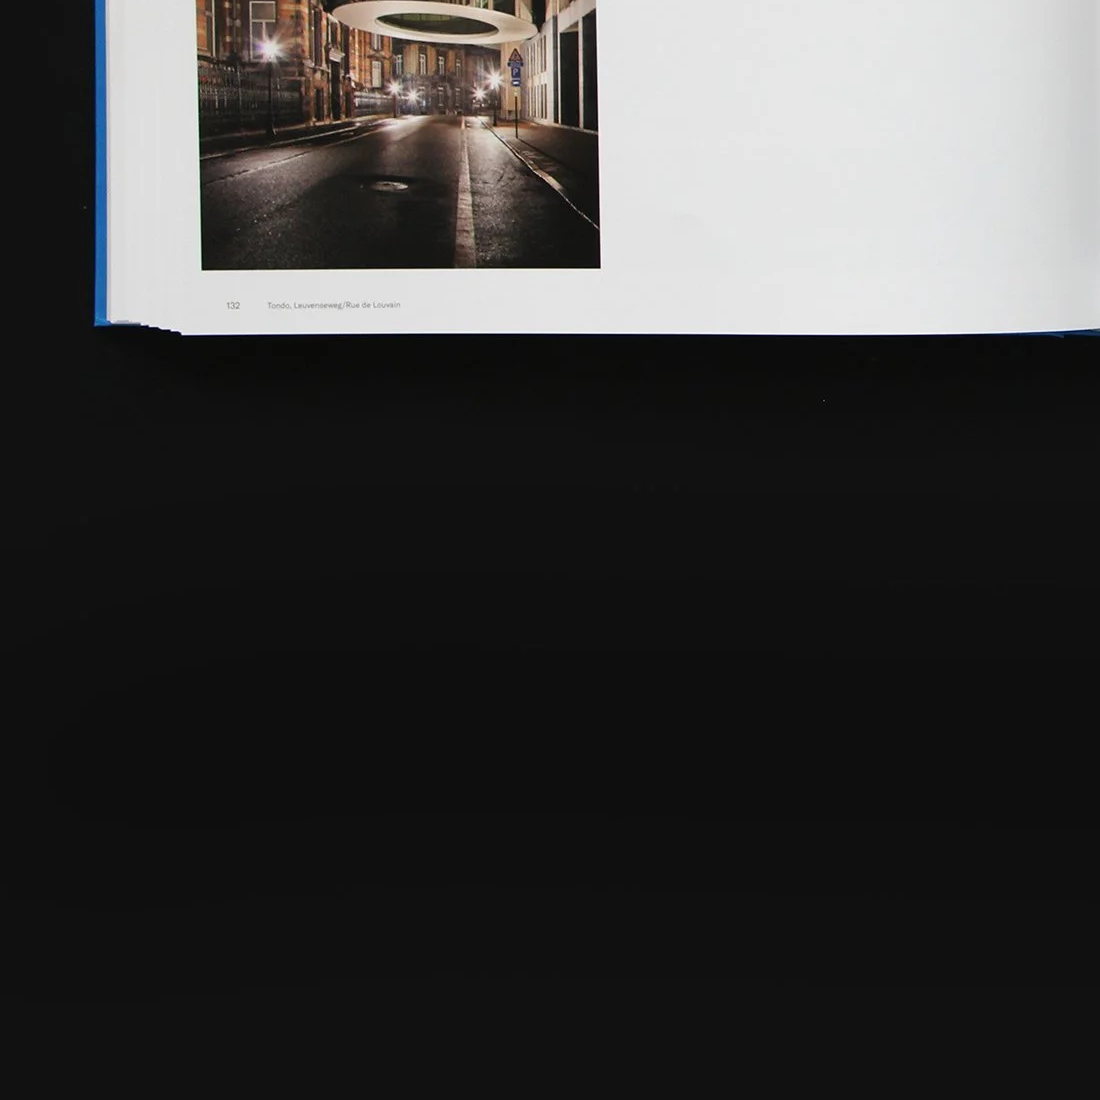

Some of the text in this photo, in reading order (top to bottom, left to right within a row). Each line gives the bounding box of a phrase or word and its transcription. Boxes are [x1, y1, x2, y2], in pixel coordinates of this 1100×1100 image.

[226, 301, 241, 310] 132
[361, 301, 371, 309] de
[372, 301, 401, 309] Louvain
